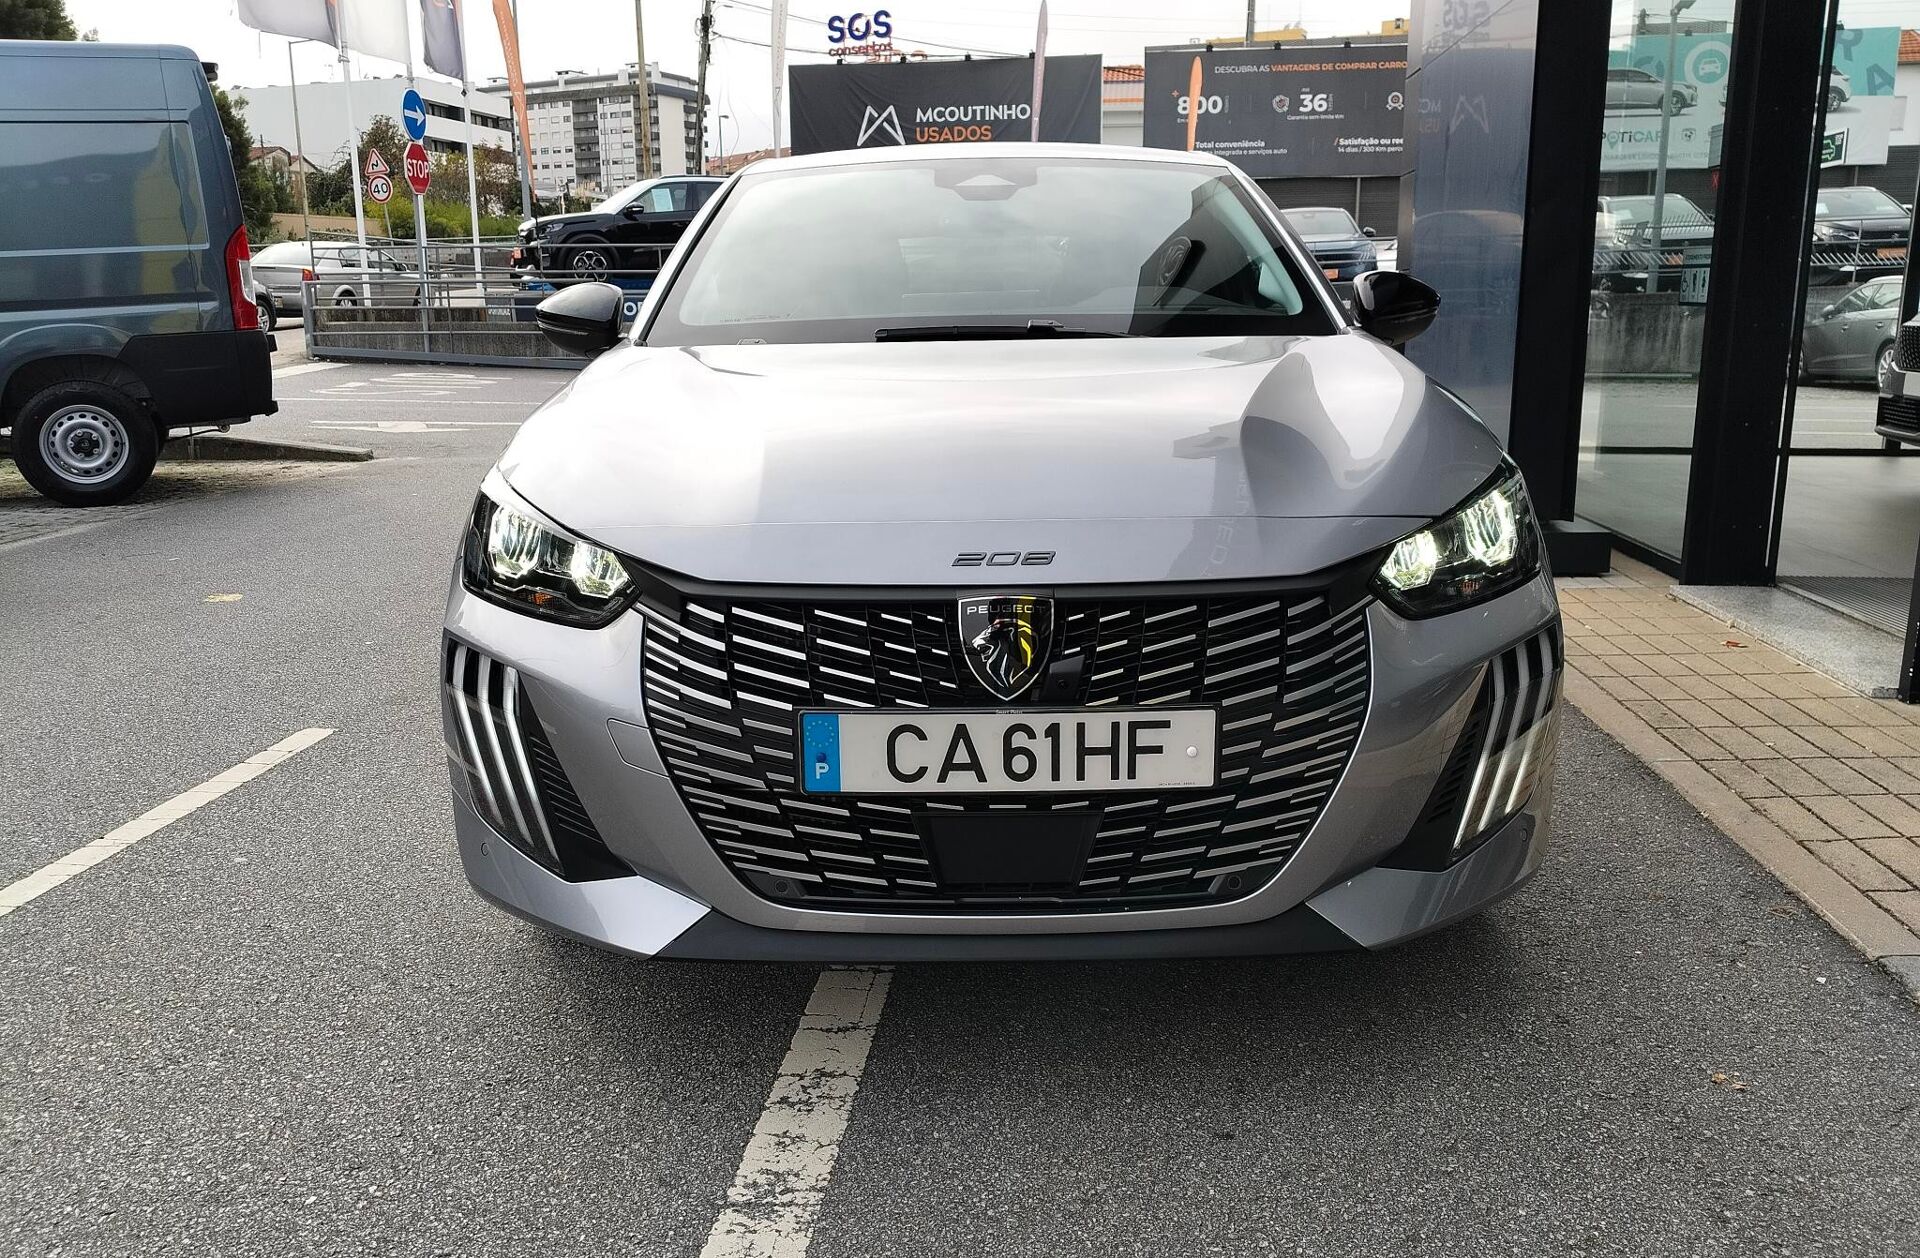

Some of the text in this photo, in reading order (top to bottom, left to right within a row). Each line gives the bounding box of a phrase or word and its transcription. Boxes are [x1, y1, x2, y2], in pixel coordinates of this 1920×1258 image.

[827, 9, 892, 43] SOS
[1214, 65, 1258, 74] DESCUBRA
[1259, 64, 1270, 72] AS
[1271, 63, 1321, 72] VANTAGENS
[1322, 63, 1334, 71] DE
[1335, 62, 1377, 71] COMPRAR
[1299, 93, 1328, 112] 36
[916, 104, 1031, 122] MCOUTINHO
[916, 126, 992, 142] USADOS
[1339, 137, 1379, 146] Satisfação
[1195, 139, 1266, 149] Total conveniência
[1248, 148, 1272, 156] serviços
[407, 158, 430, 179] STOP
[373, 182, 389, 195] 40
[951, 551, 1056, 567] 208
[966, 604, 1046, 615] PEUGEOT
[886, 720, 1172, 784] CA 61 HF
[815, 762, 830, 780] P
